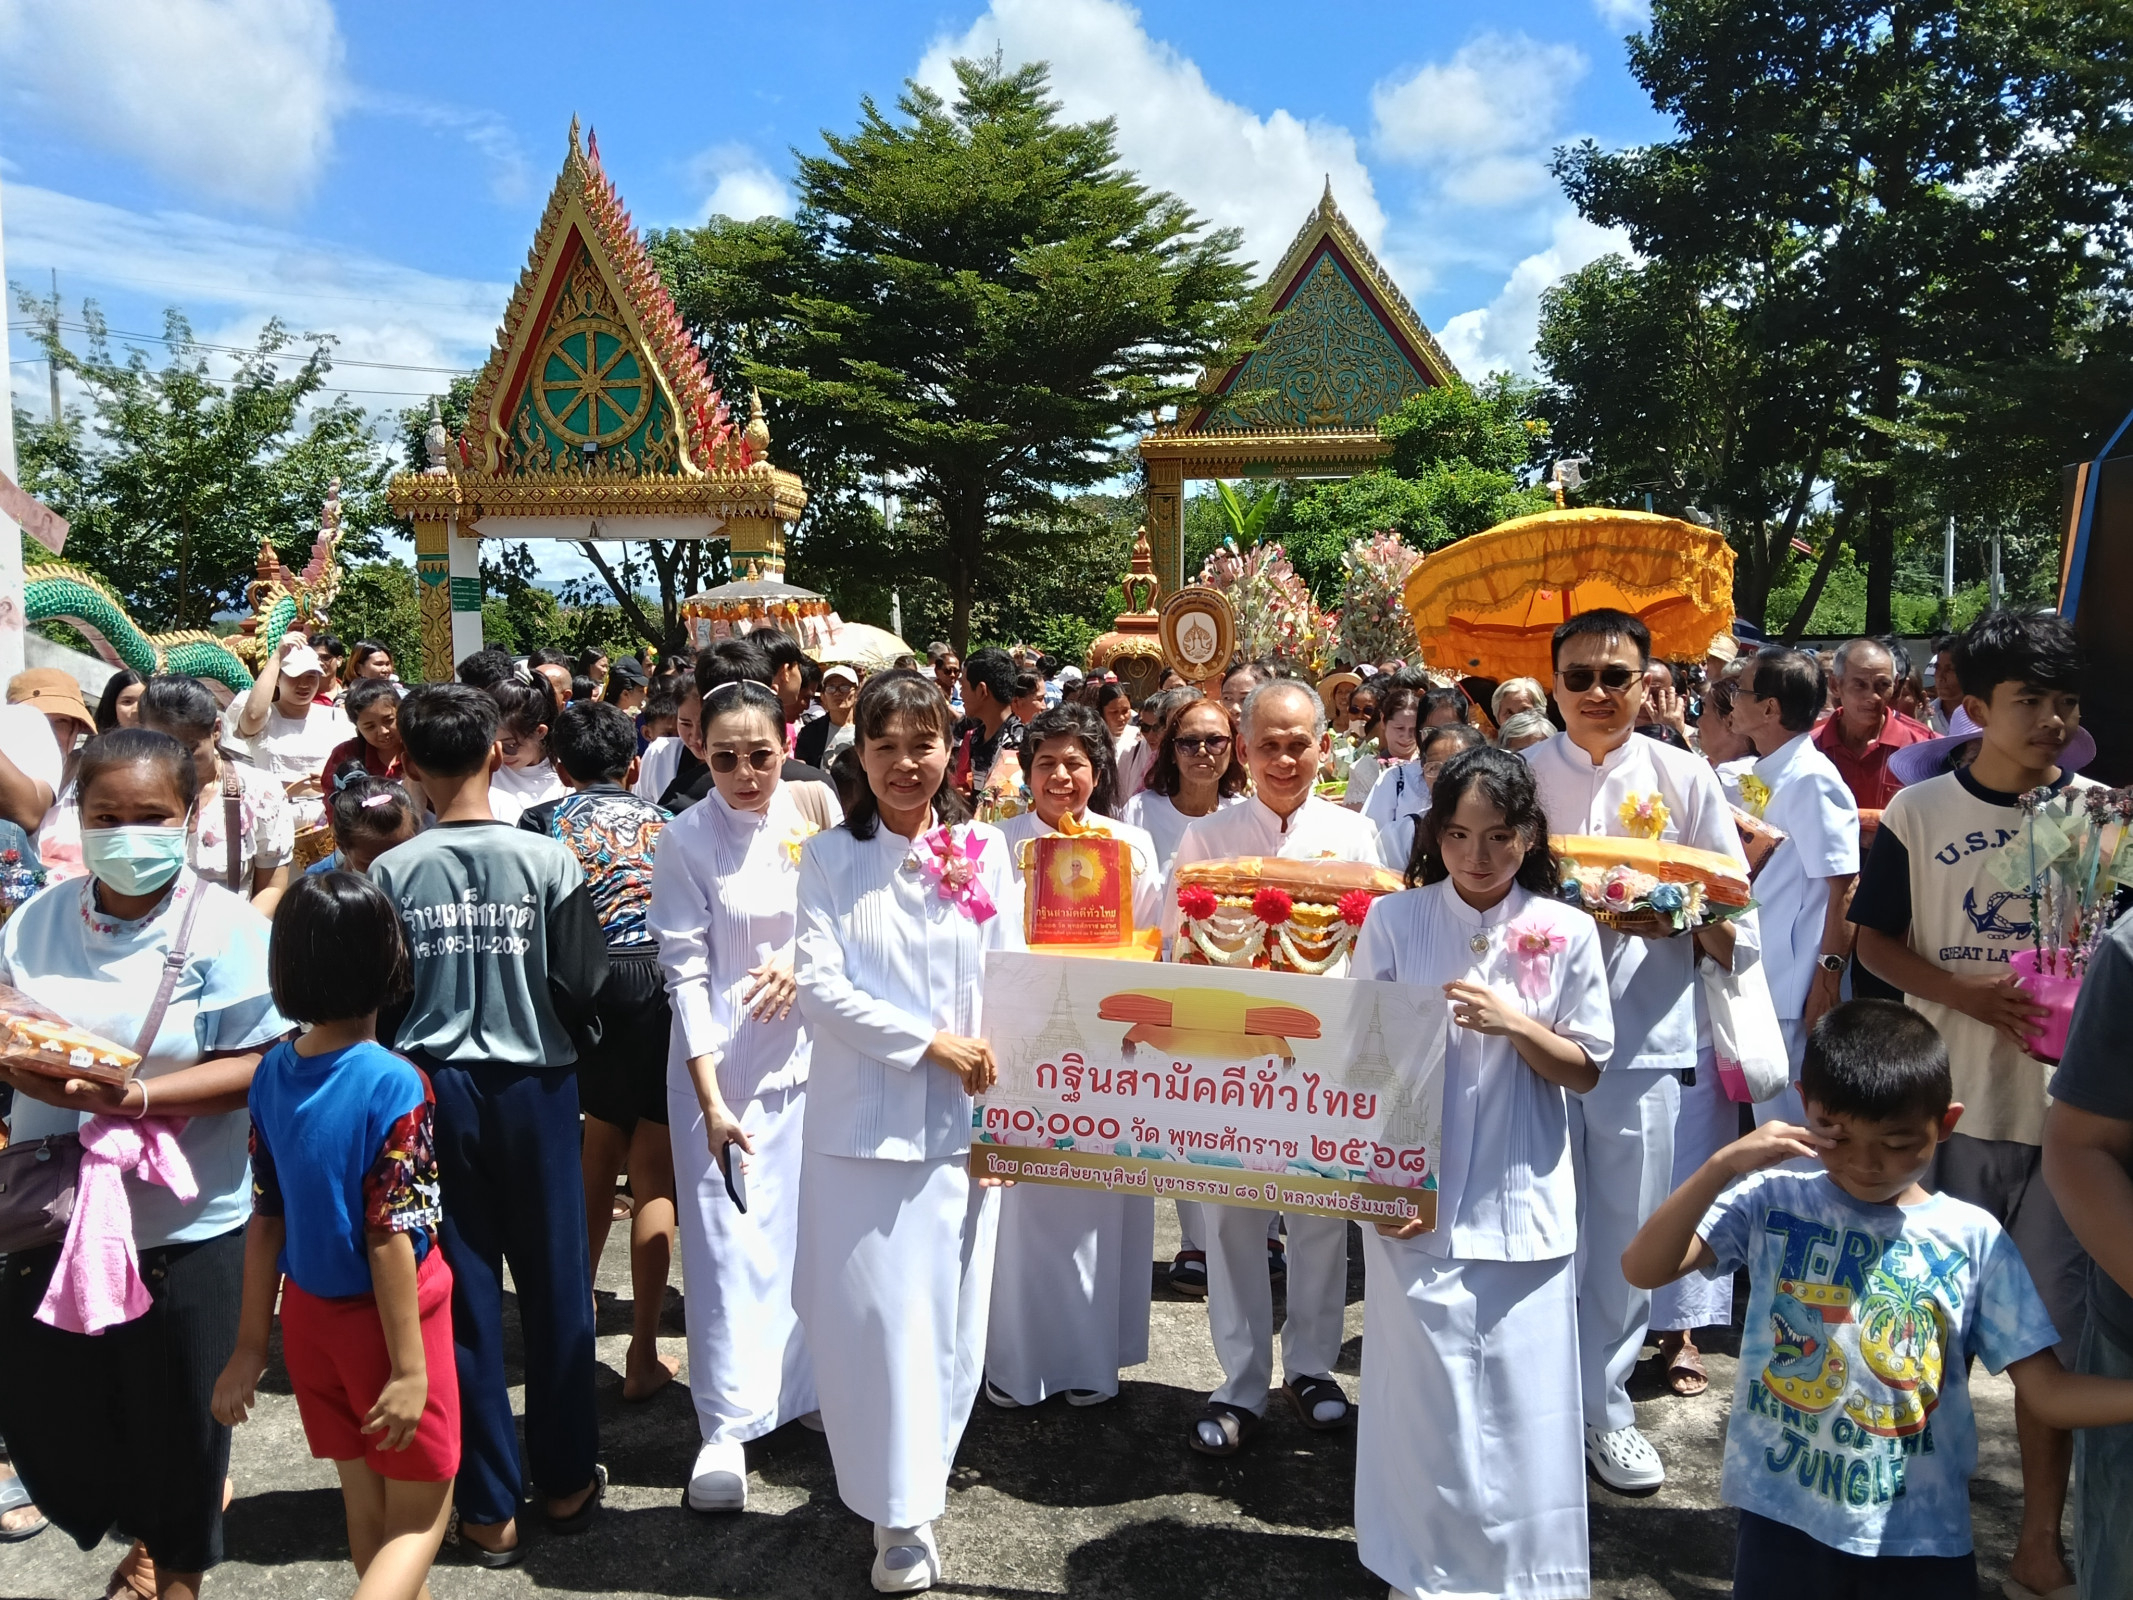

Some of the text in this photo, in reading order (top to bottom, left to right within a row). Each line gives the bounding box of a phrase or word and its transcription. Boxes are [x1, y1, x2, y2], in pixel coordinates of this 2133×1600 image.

[1035, 1052, 1377, 1120] กฐินสามัคคีทั่วไทย
[986, 1106, 1426, 1172] ๓๐,๐๐๐ วัด พุทธศักราช ๒๕๖๘
[986, 1155, 1417, 1217] โดย คณะศิษยานุศิษย์ บูชาธรรม ๘๑ ปี หลวงพ่อธัมมชโย
[1765, 1206, 1970, 1309] T-REX
